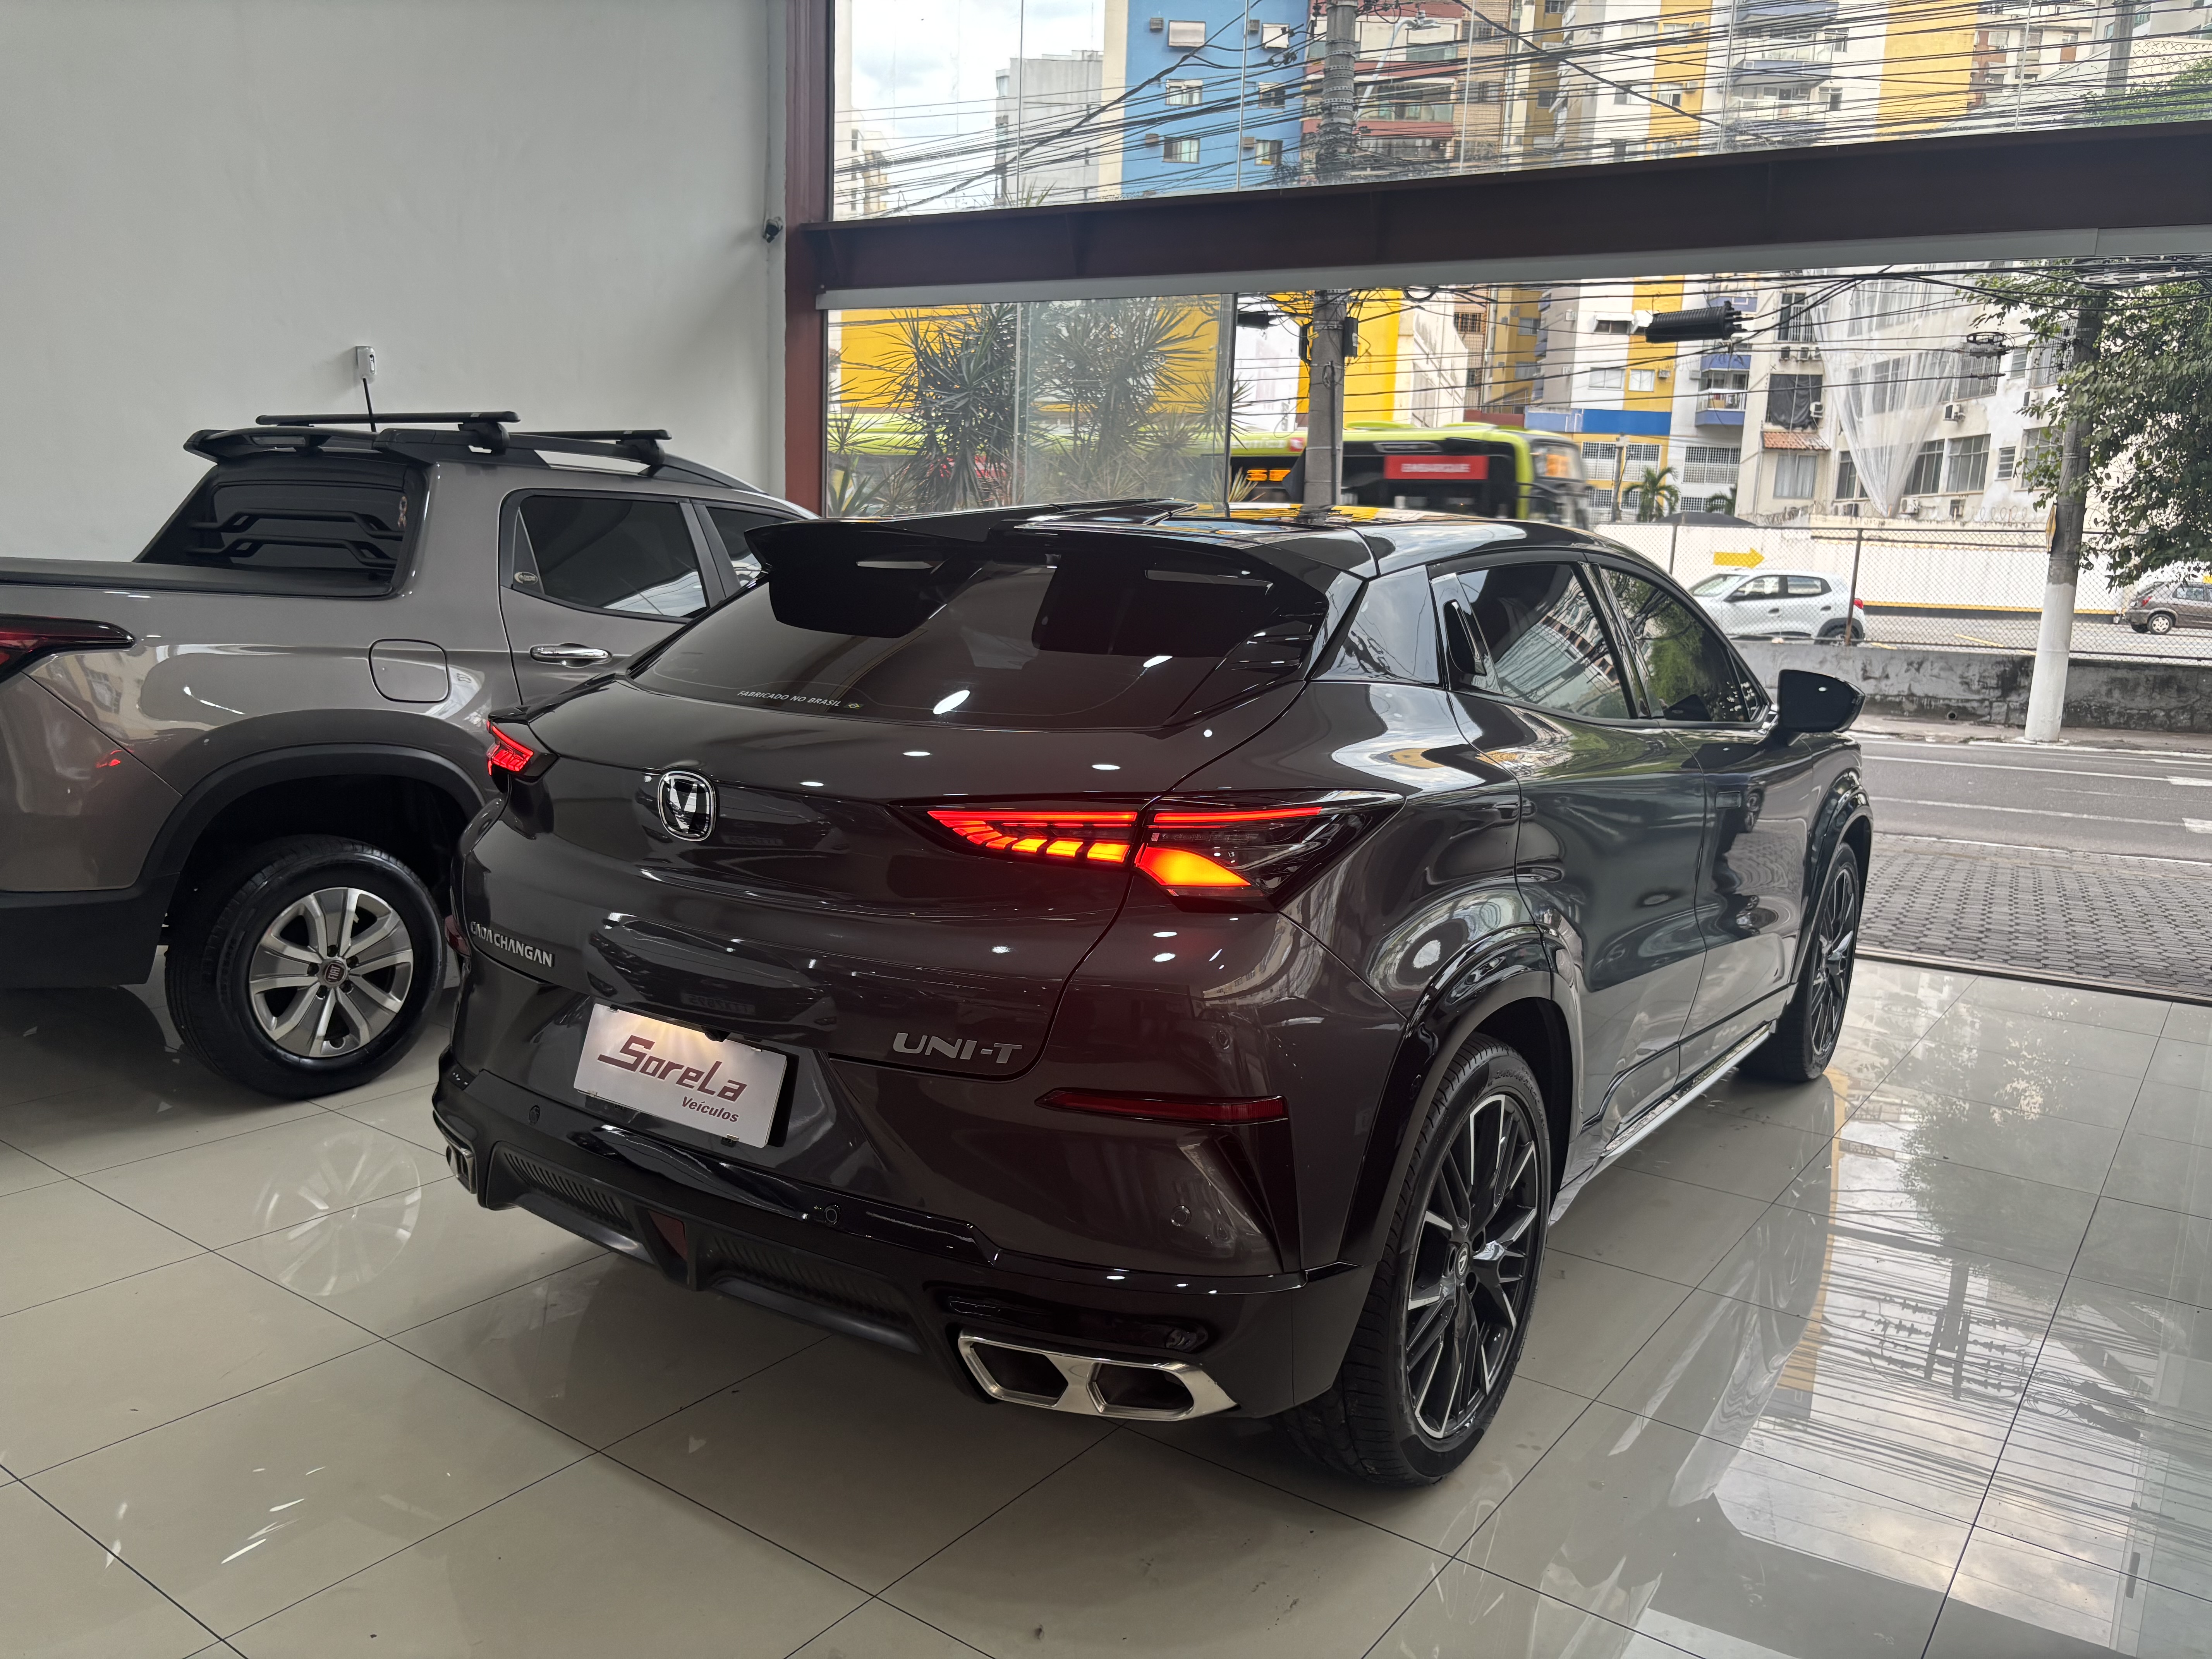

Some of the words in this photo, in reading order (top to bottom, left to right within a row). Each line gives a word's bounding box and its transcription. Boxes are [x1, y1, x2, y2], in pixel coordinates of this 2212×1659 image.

[737, 691, 789, 700] FABRICADO
[807, 697, 842, 707] BRASIL
[494, 933, 553, 967] CHANGAN
[328, 965, 341, 979] FIAT
[893, 1032, 1023, 1064] UNI-T
[682, 1096, 740, 1122] Veículos
